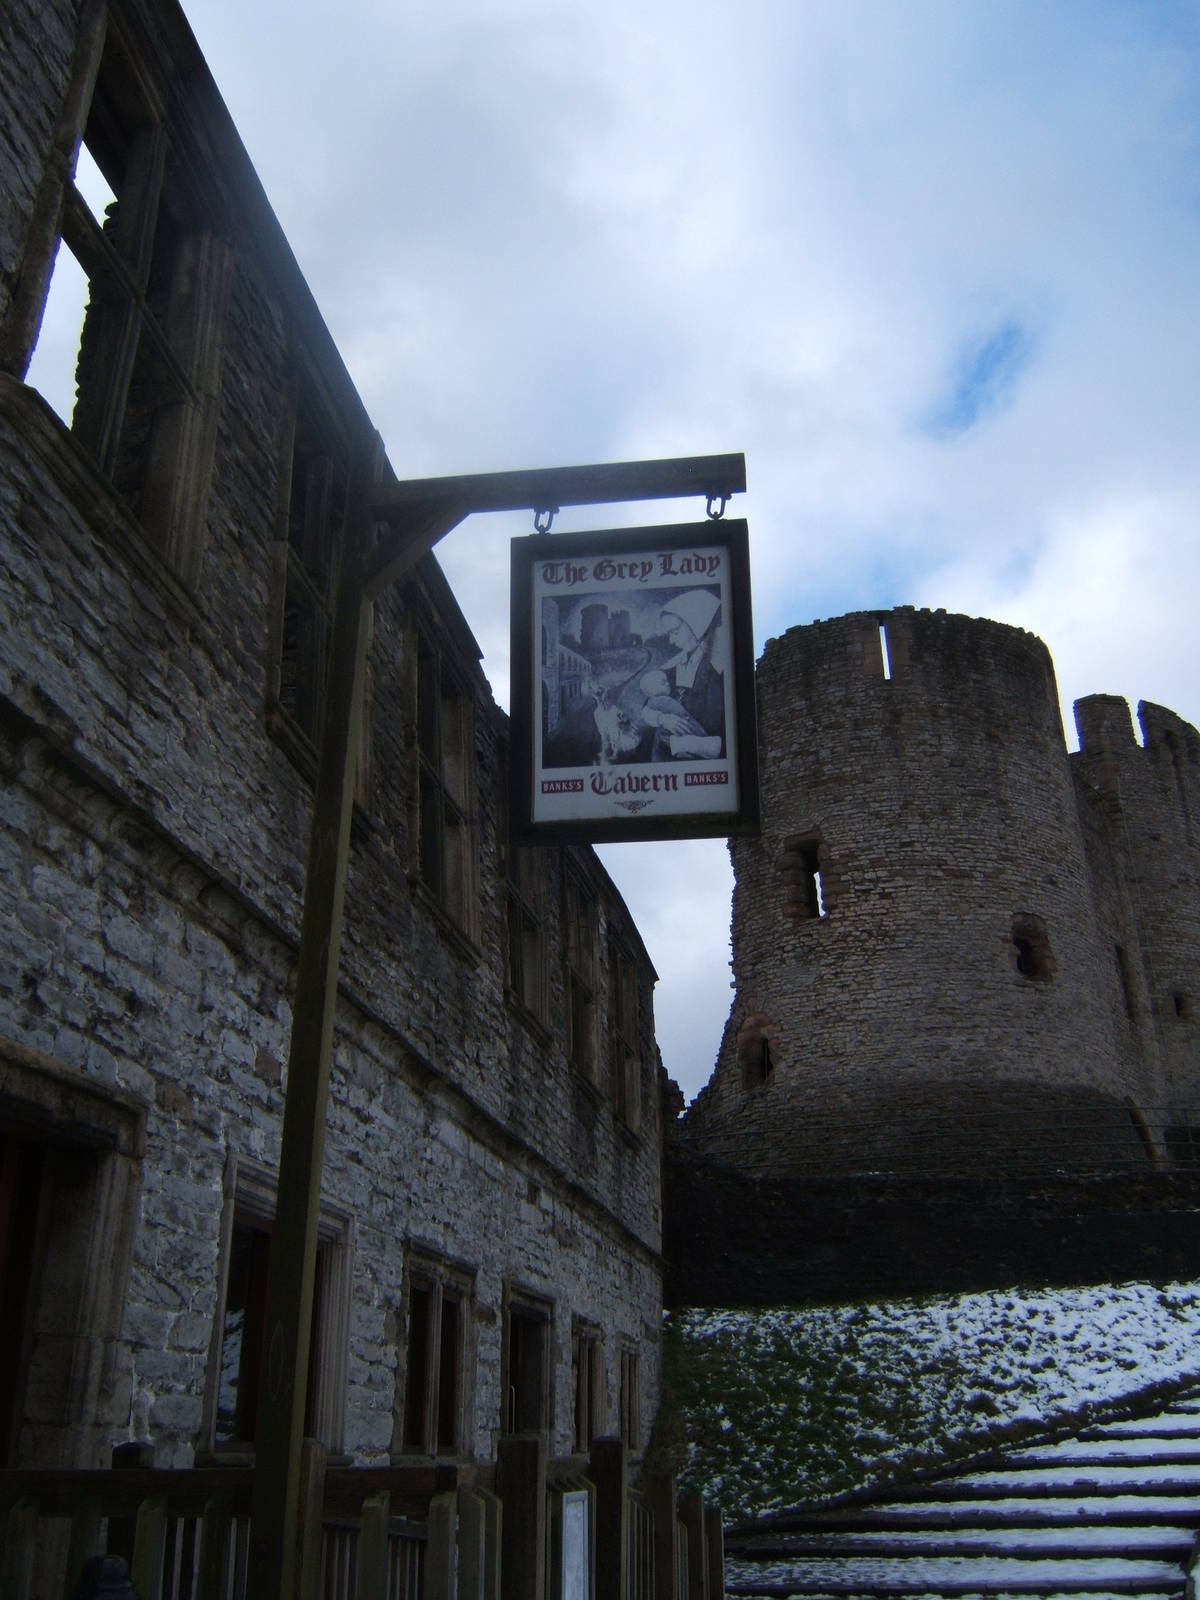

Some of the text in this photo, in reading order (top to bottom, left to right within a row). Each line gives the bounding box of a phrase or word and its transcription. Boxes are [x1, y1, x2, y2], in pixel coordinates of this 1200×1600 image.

[542, 552, 721, 587] The Grey Lady
[542, 780, 583, 793] BANKS'S
[590, 771, 679, 796] Tavern
[686, 772, 727, 785] BANKS'S
